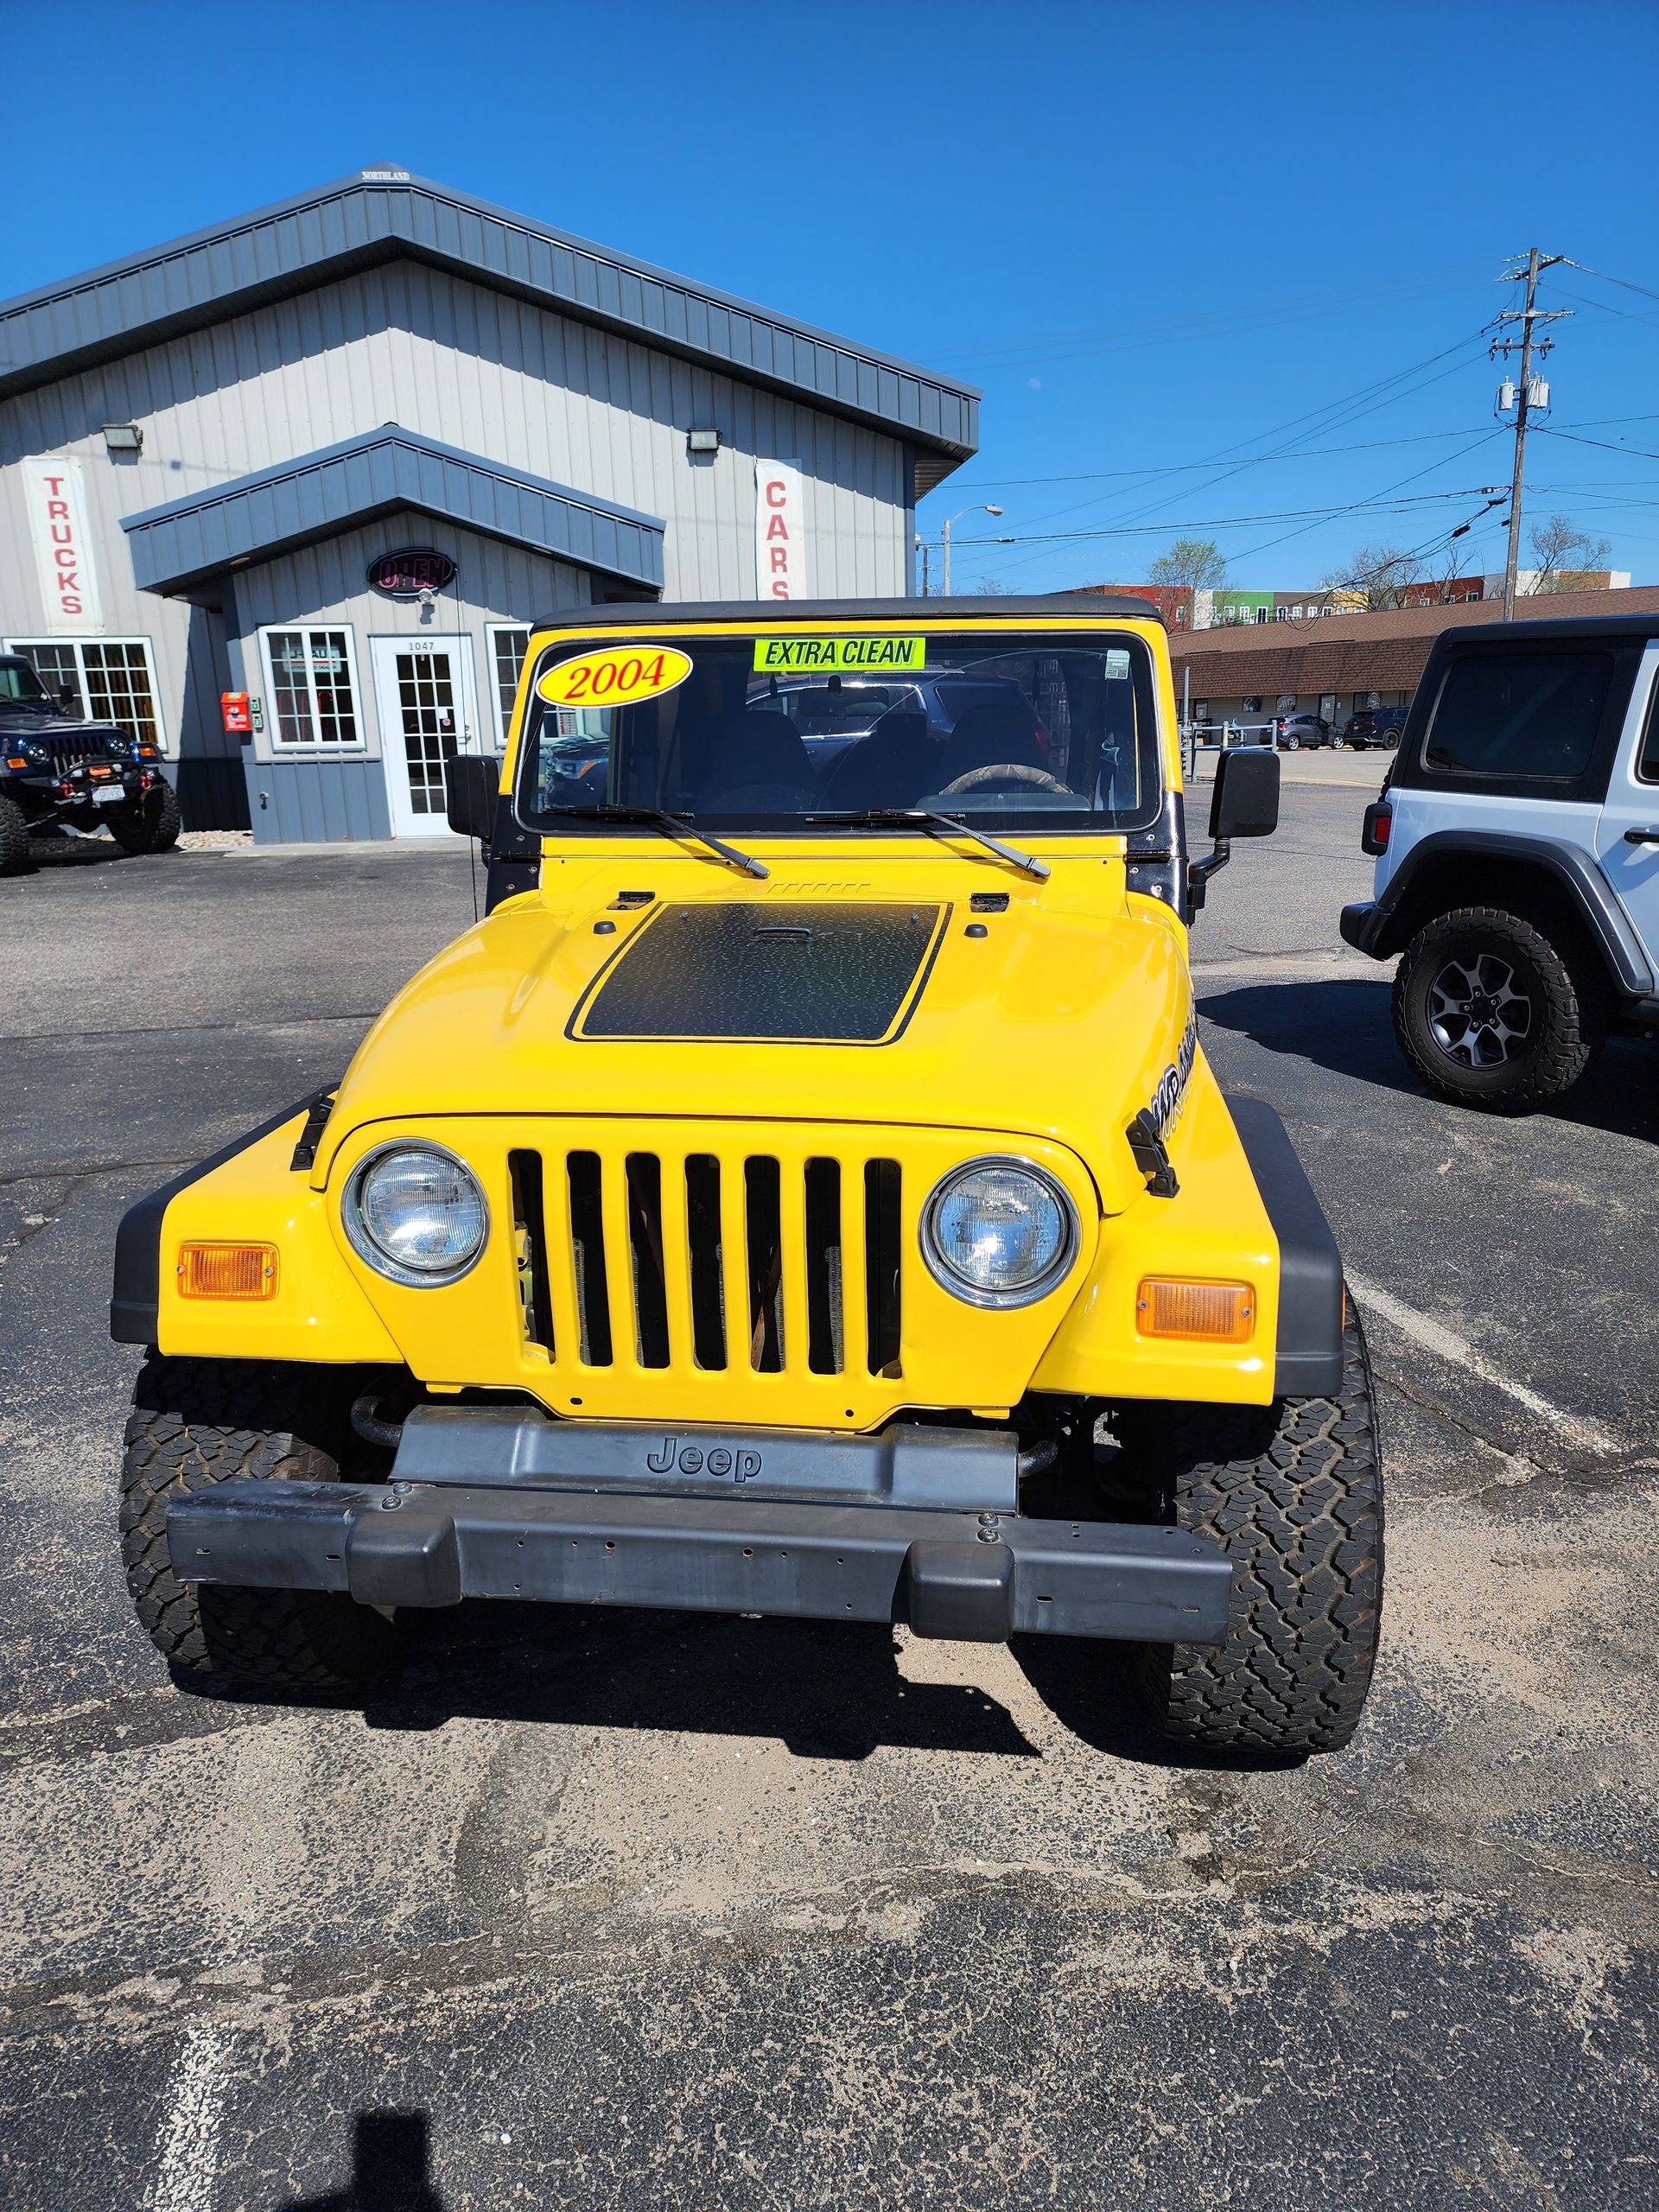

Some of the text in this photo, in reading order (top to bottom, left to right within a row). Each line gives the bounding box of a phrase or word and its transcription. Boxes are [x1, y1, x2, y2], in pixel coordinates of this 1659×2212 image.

[42, 476, 84, 614] TRUCKS
[766, 480, 790, 601] CARS
[379, 558, 445, 588] OPEN
[409, 642, 434, 651] 1047
[765, 639, 918, 667] EXTRA CLEAN
[563, 653, 666, 700] 2004
[647, 1437, 762, 1484] Jeep
